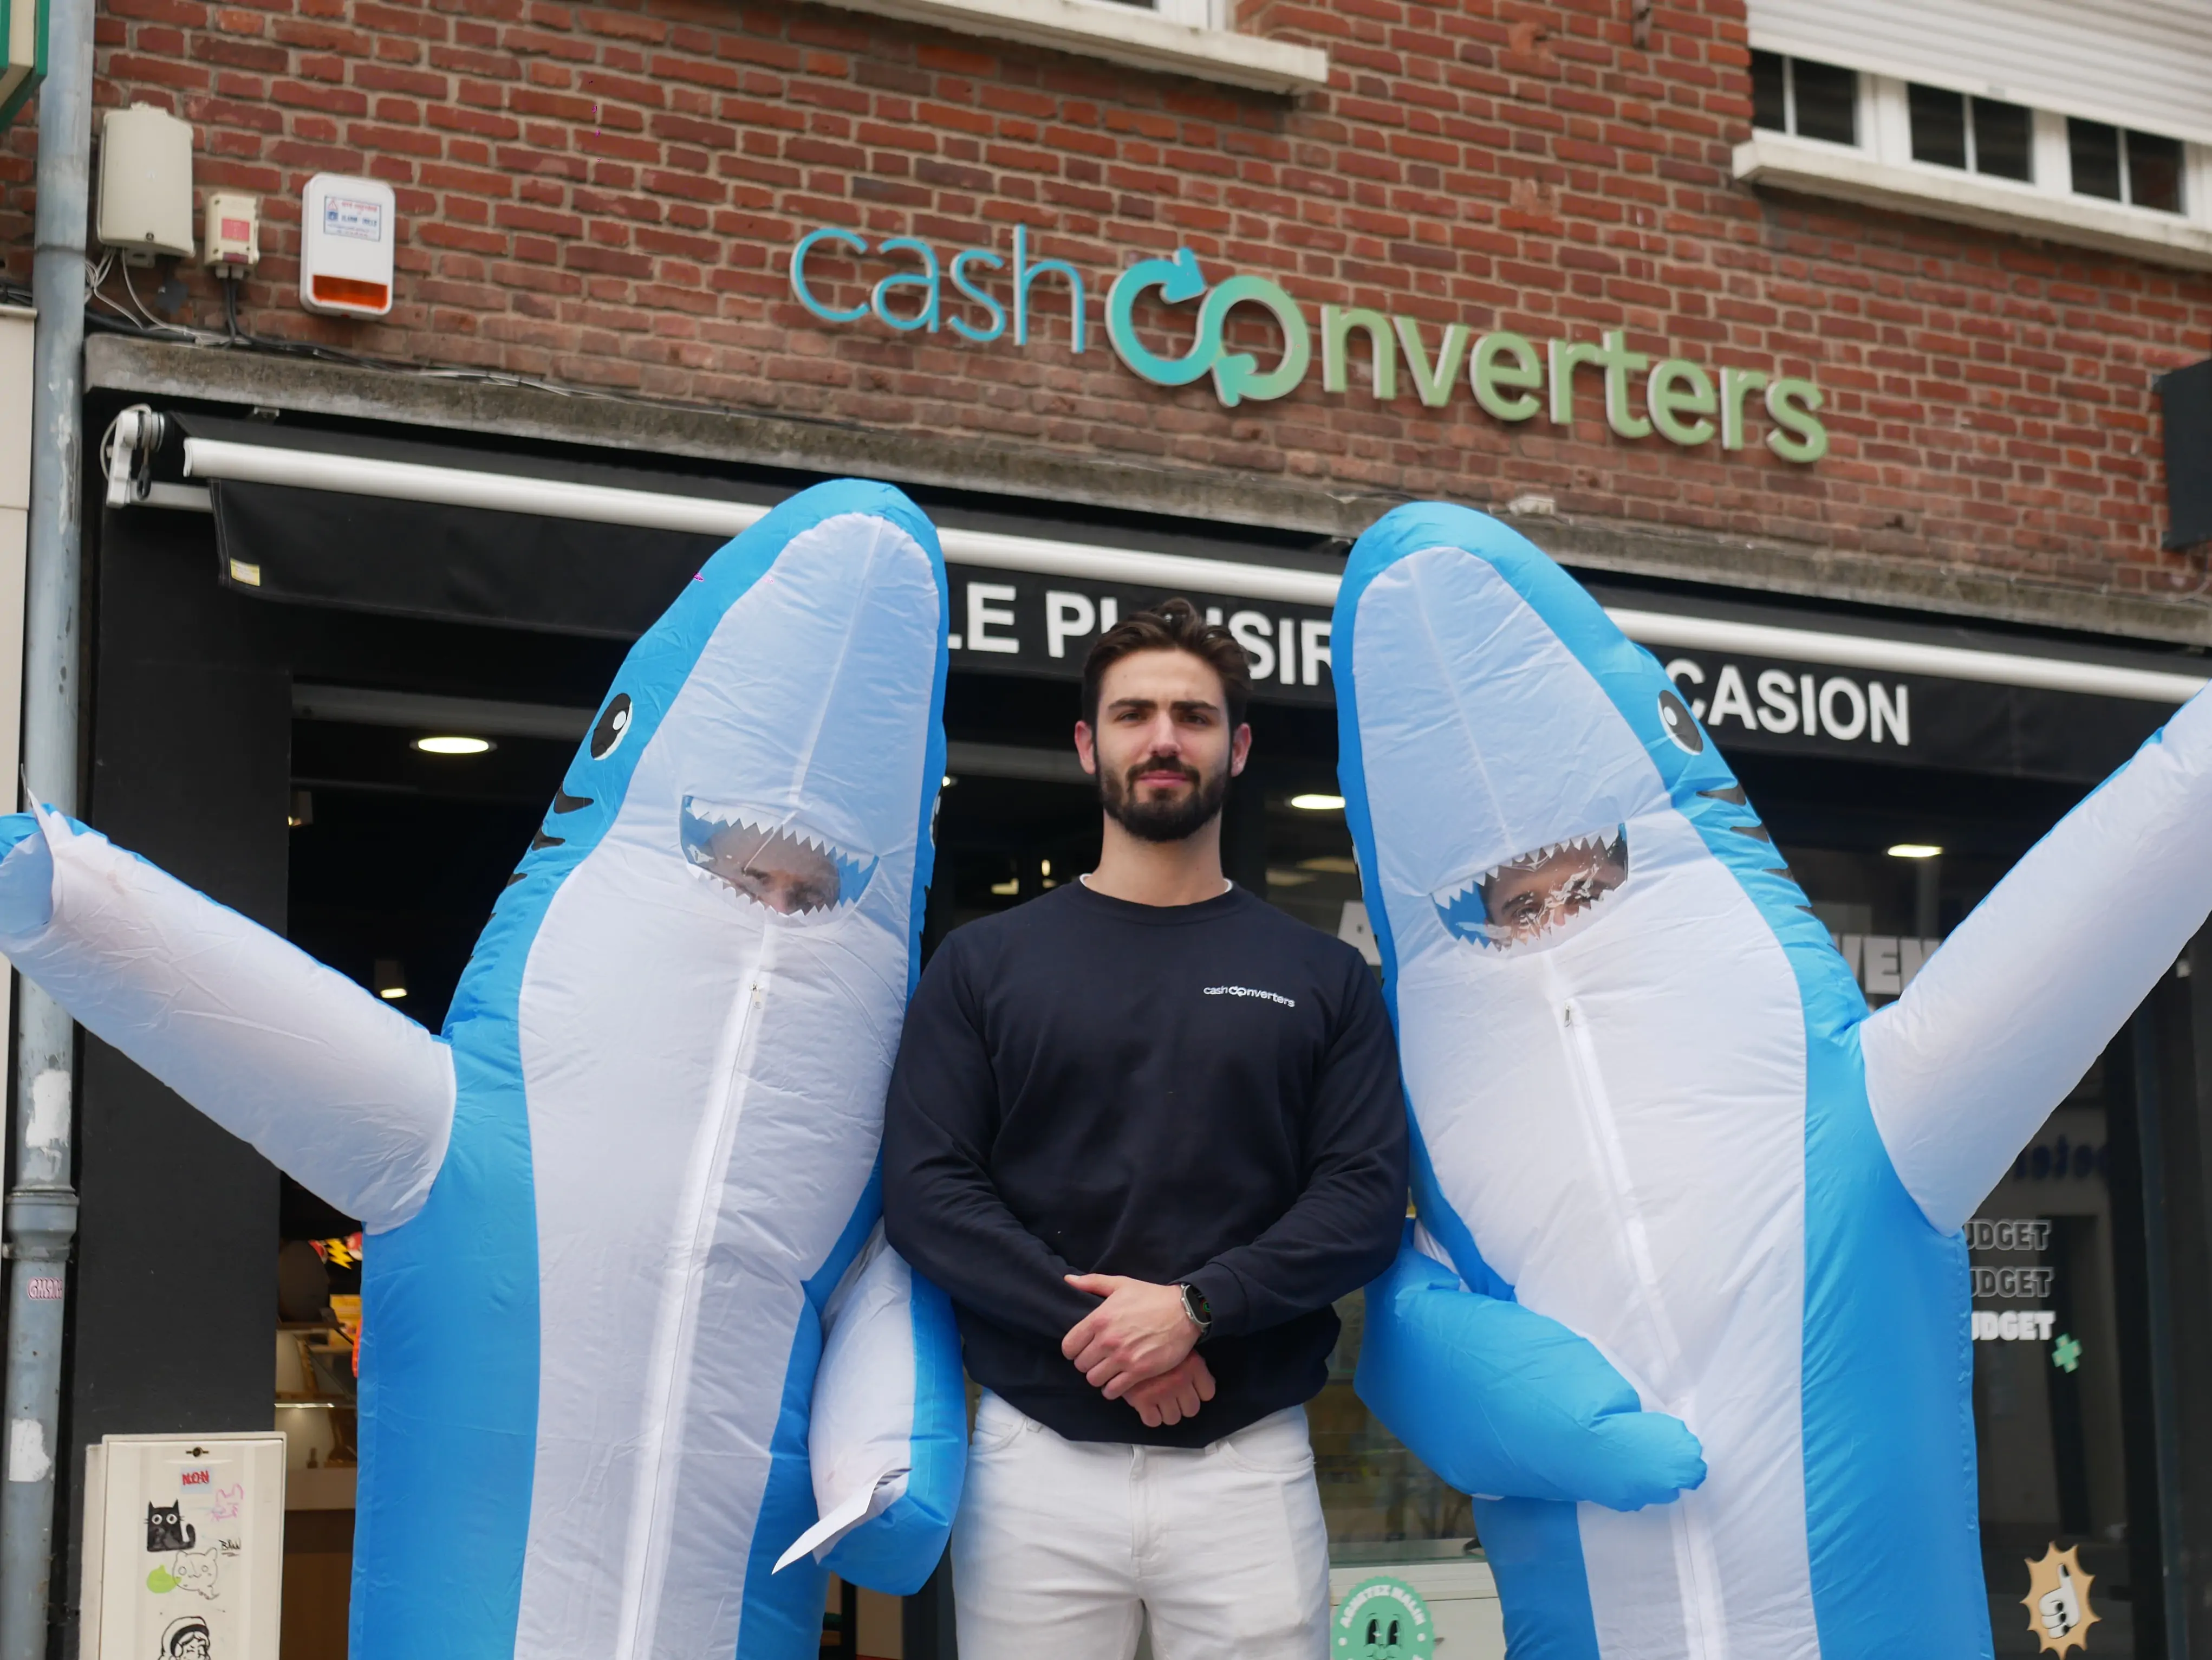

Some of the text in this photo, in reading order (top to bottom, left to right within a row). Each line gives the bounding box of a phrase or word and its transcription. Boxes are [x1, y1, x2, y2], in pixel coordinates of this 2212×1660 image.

[790, 223, 1084, 354] cash
[948, 582, 1019, 653] E
[1203, 985, 1228, 995] cash
[181, 1469, 210, 1486] NON
